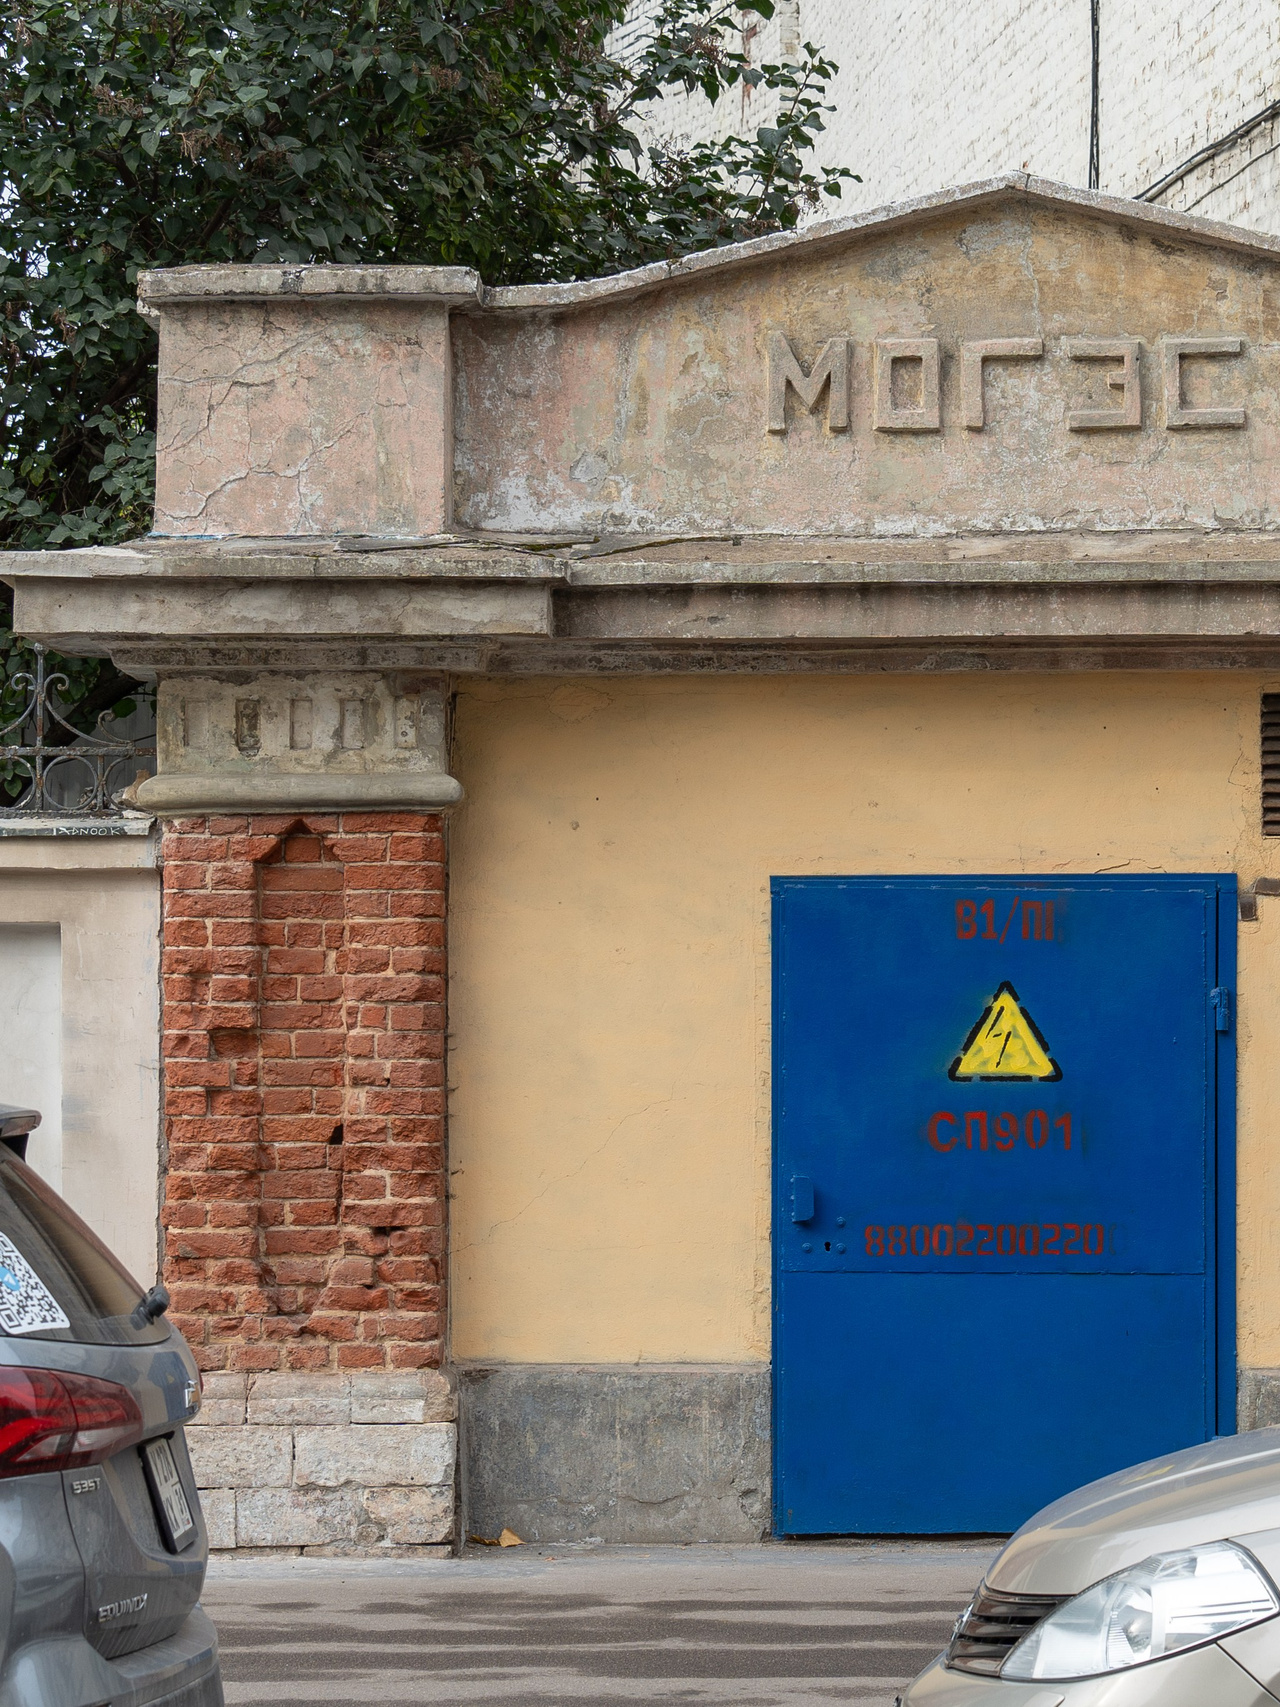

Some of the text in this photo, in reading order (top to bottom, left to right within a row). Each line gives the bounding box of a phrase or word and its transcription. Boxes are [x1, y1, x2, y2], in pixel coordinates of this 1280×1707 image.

[766, 330, 1246, 435] МОГЭС
[927, 1109, 1072, 1152] СП901
[864, 1223, 1105, 1257] 88002200220
[72, 1477, 101, 1495] 535T
[98, 1592, 148, 1623] EQUINOX
